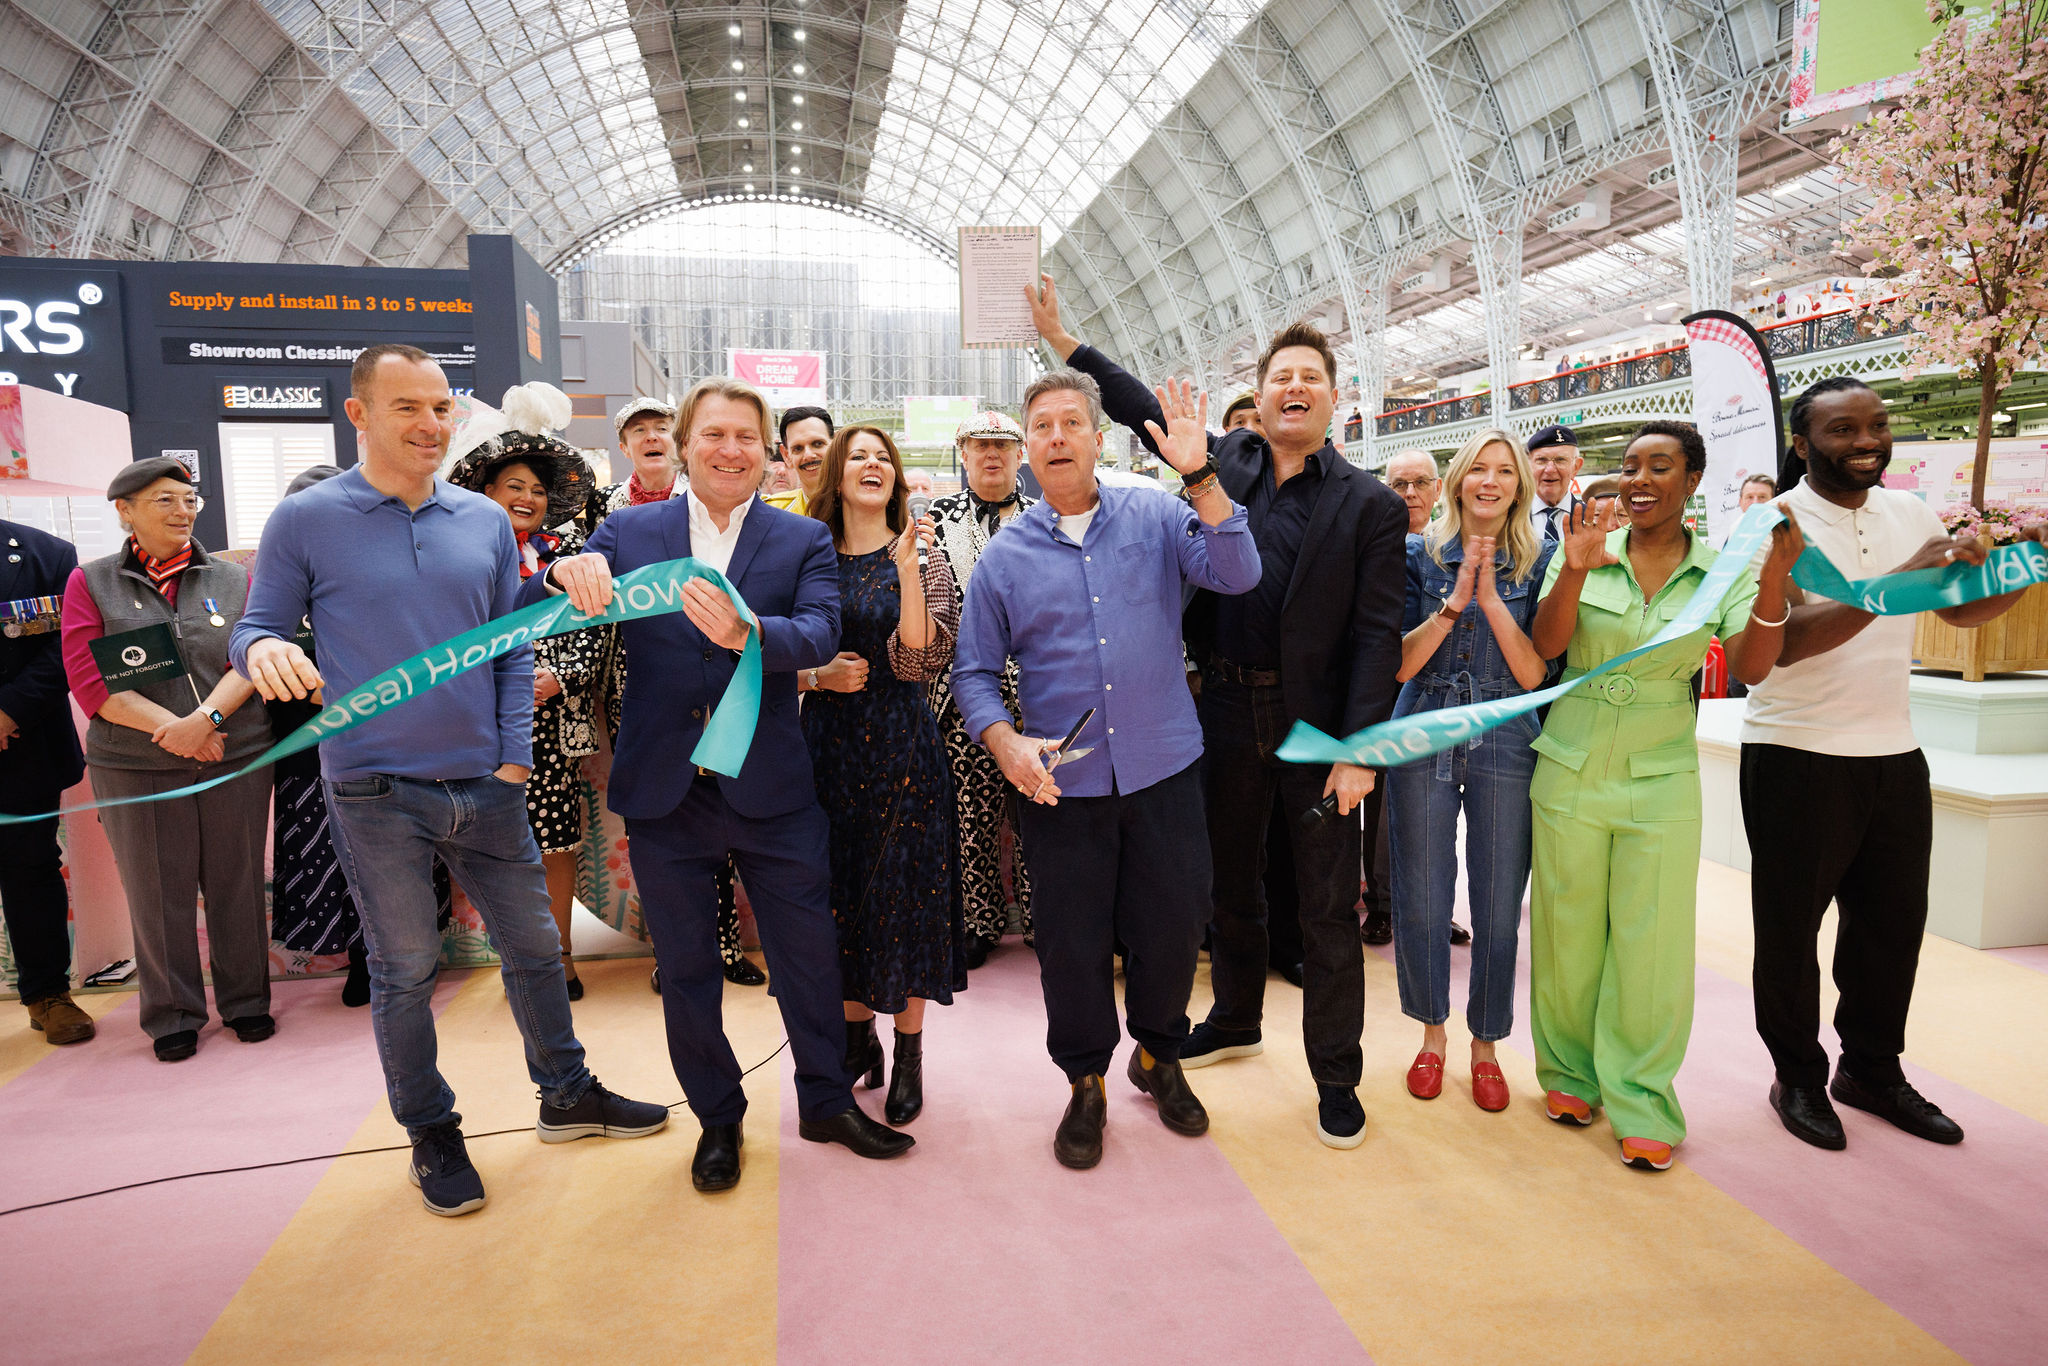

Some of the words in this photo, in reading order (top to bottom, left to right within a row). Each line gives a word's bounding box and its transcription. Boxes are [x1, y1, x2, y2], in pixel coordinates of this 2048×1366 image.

[169, 291, 235, 311] Supply
[240, 293, 275, 308] and
[279, 293, 338, 309] install
[342, 295, 361, 310] in
[366, 296, 377, 311] 3
[381, 297, 400, 311] to
[405, 297, 416, 312] 5
[189, 343, 282, 359] Showroom
[285, 345, 368, 363] Chessing
[756, 365, 799, 375] DREAM
[760, 375, 796, 384] HOME
[249, 387, 322, 402] CLASSIC
[1989, 551, 2048, 590] Ide
[105, 673, 120, 681] THE
[119, 669, 134, 678] NOT
[135, 659, 175, 674] FORGOTTEN
